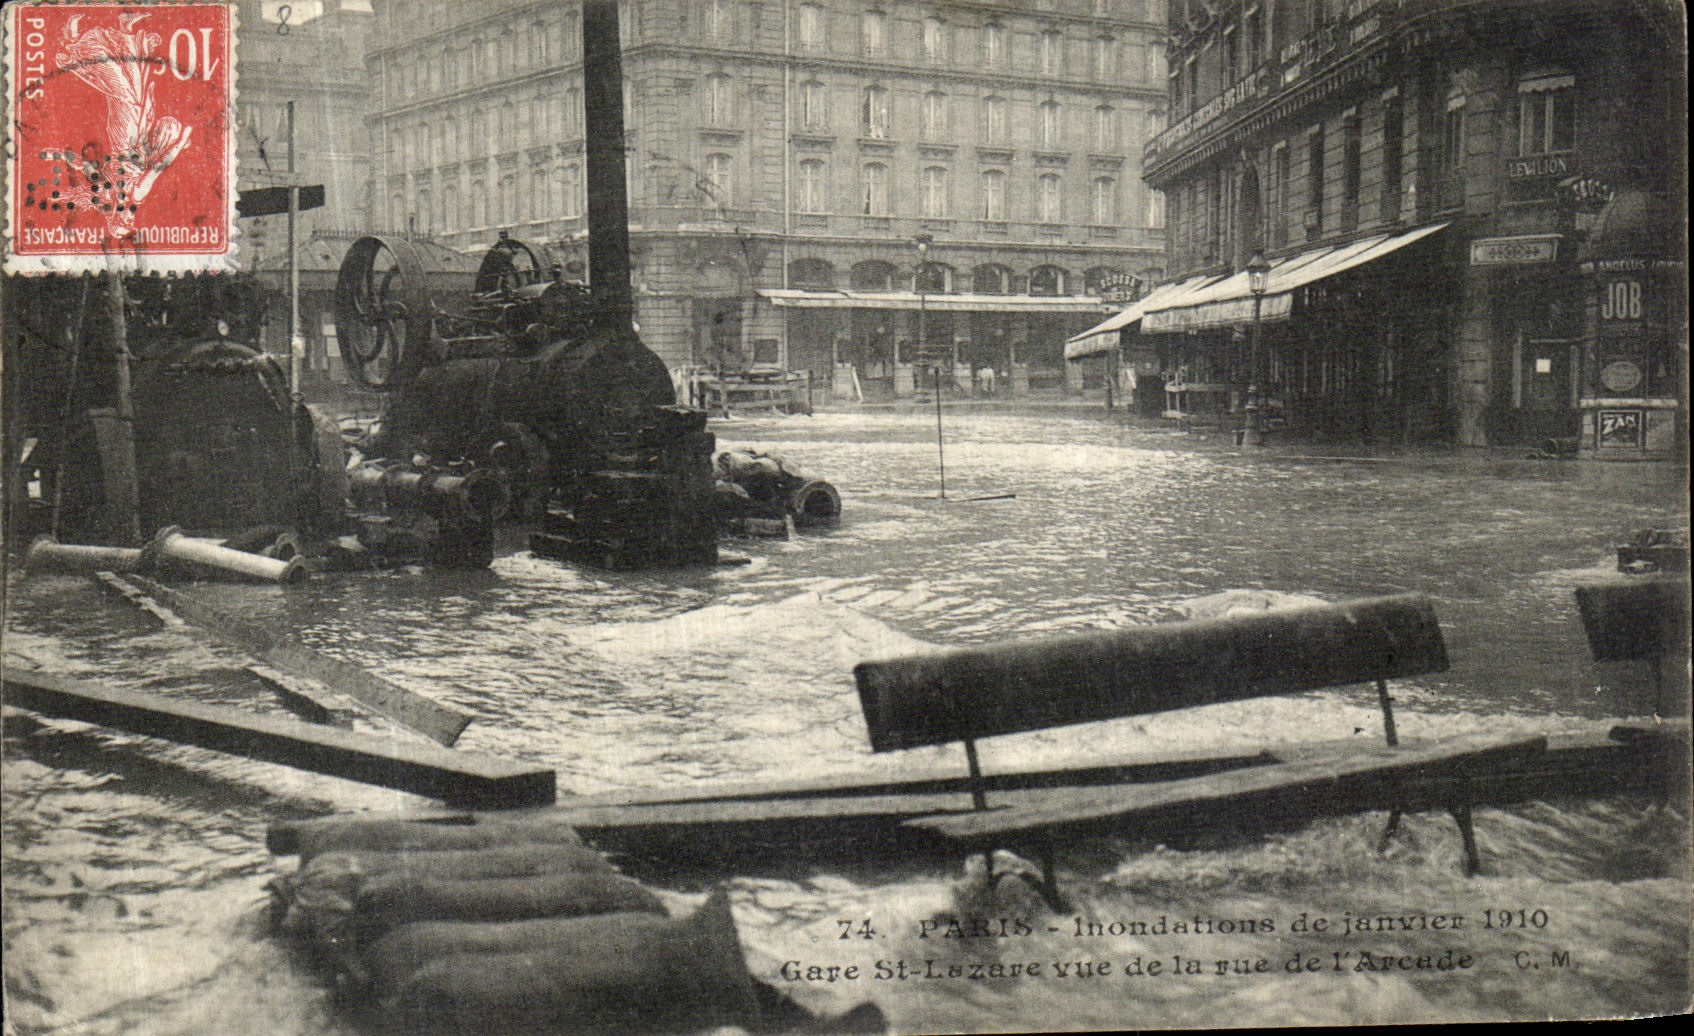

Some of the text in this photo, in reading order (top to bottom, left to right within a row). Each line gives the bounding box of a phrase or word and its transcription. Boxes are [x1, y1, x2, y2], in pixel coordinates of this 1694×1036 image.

[26, 17, 45, 100] POSTES
[24, 225, 219, 245] REPUBLIQUE FRANÇAISE
[1602, 281, 1642, 319] JOB
[1601, 414, 1637, 435] ZAN
